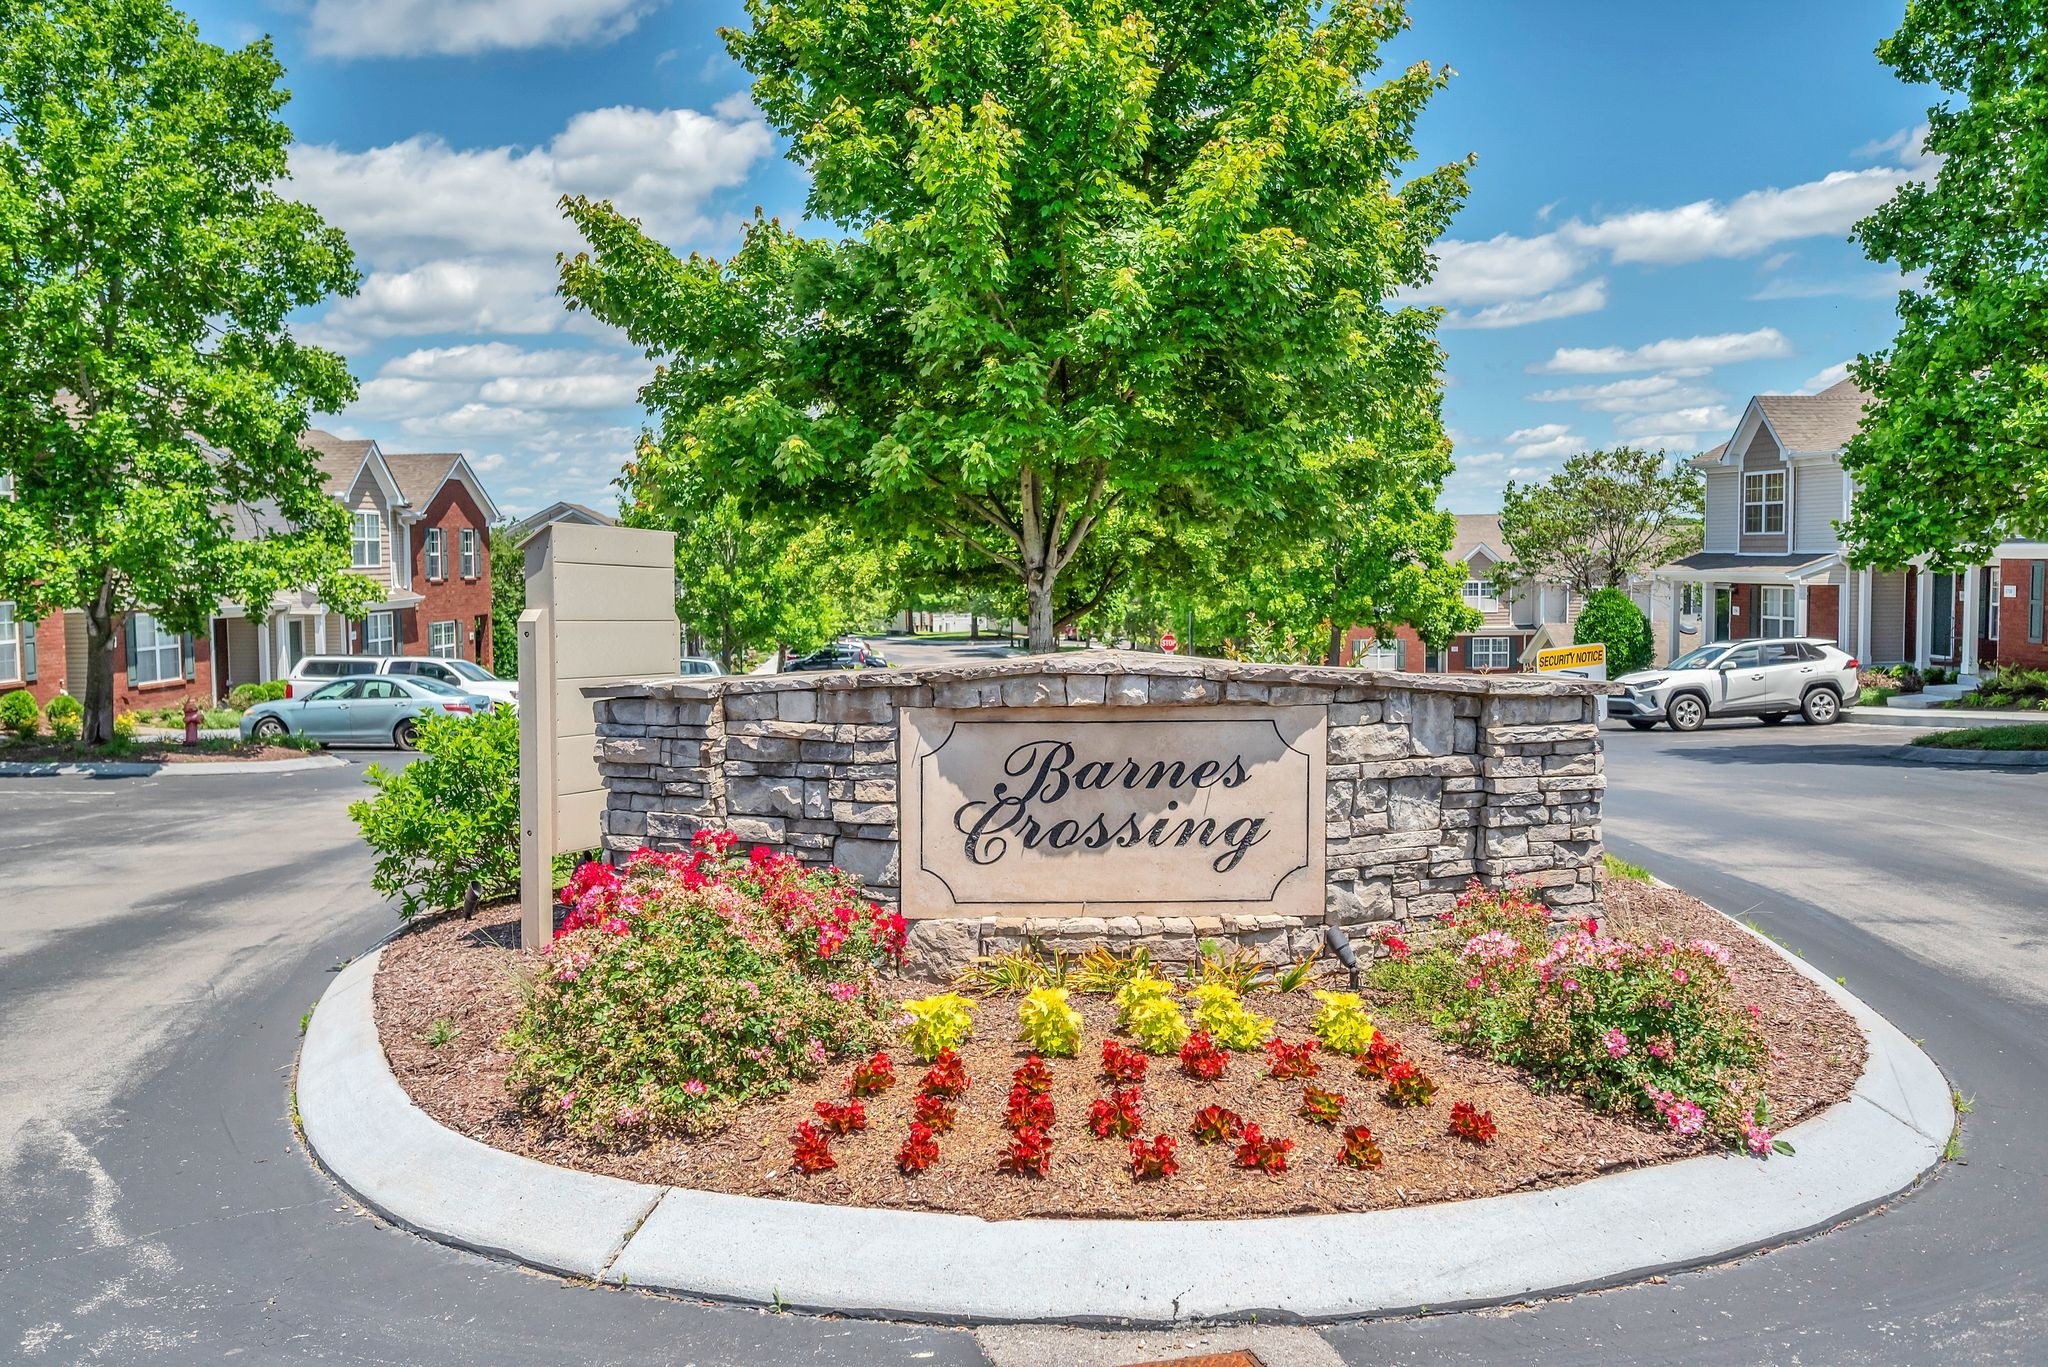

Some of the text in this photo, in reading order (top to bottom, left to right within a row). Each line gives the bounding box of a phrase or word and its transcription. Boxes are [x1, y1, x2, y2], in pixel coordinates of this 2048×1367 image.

[1162, 639, 1177, 647] STOP
[1539, 650, 1603, 667] SECURITY NOTICE
[993, 740, 1252, 805] Barnes
[953, 796, 1271, 874] Crossing
